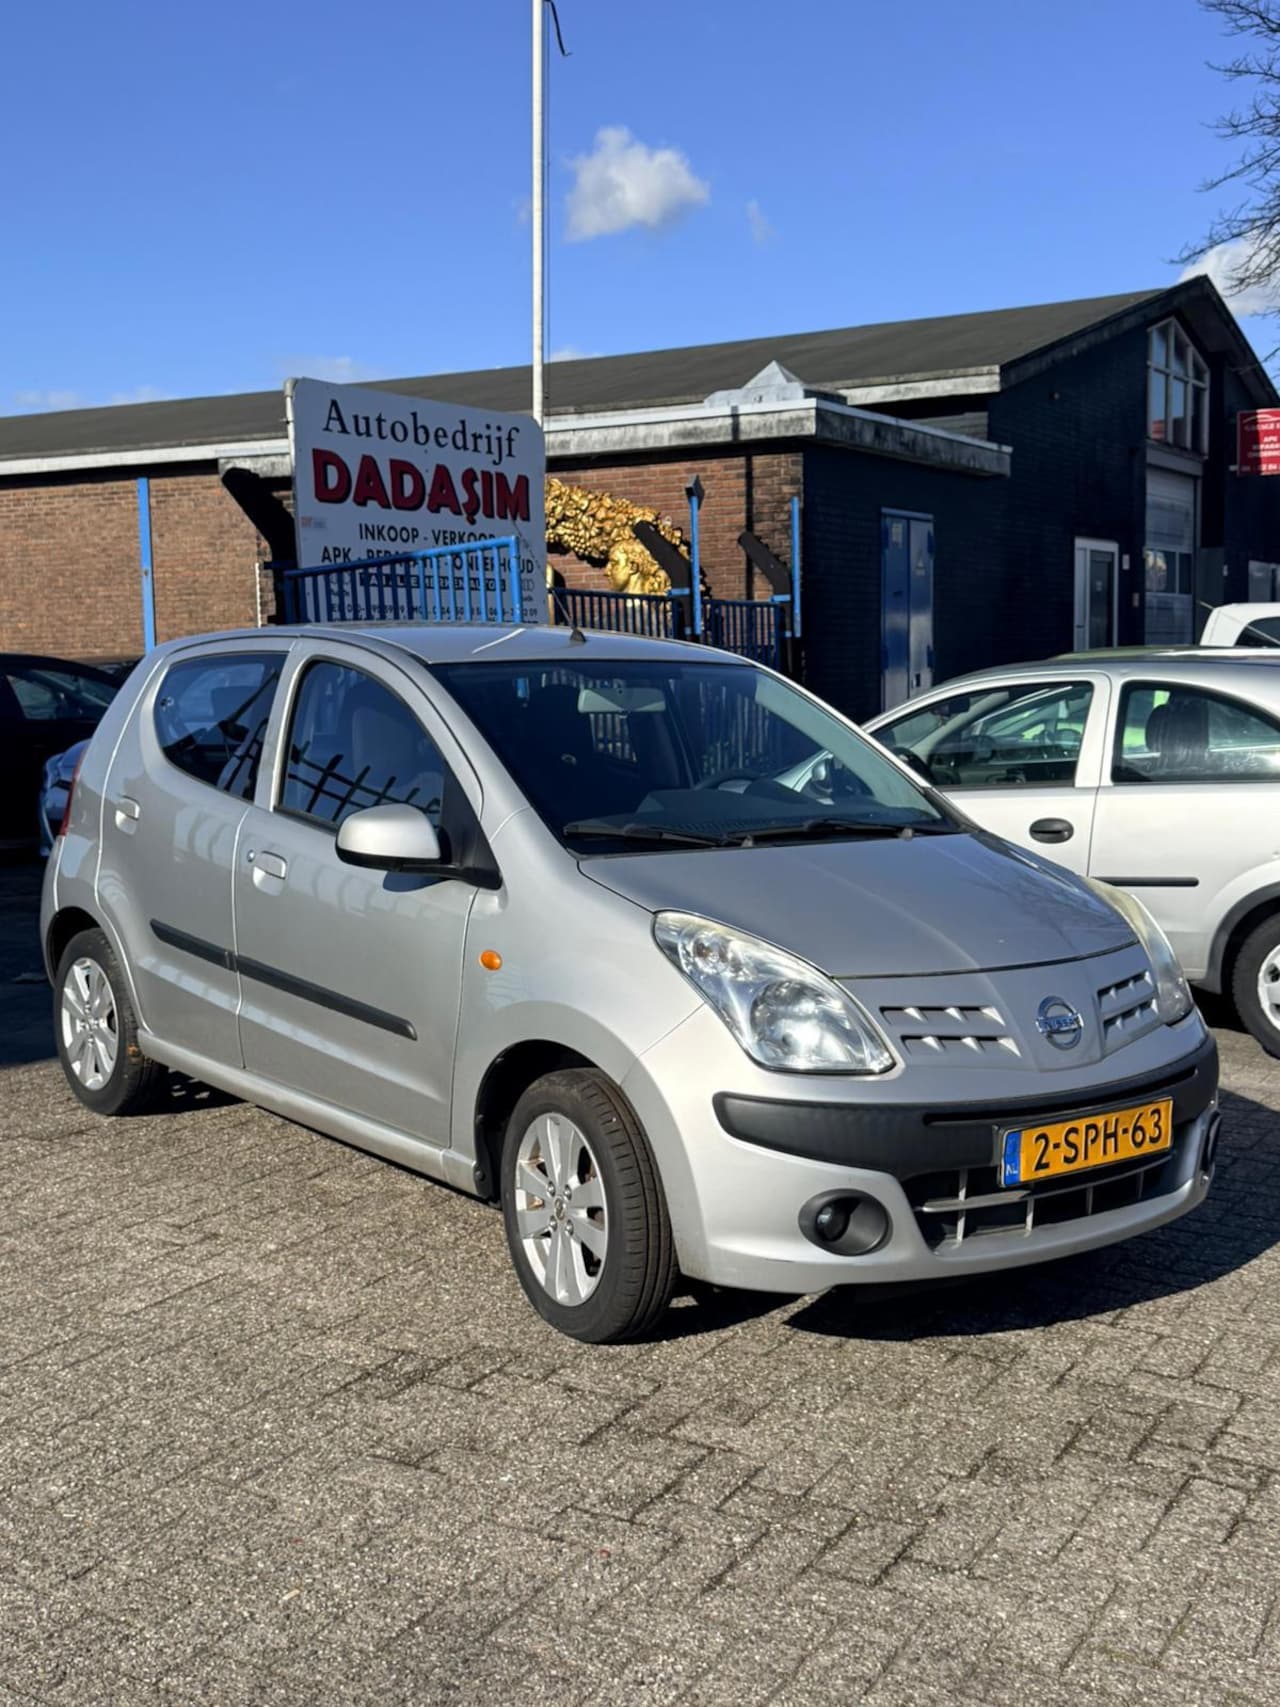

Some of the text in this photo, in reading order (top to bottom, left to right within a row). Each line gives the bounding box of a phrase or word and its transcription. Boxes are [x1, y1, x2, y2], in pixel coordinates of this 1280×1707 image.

[322, 399, 520, 466] Autobedrijf
[312, 448, 530, 526] DADAŞIM
[359, 522, 419, 543] INKOOP
[321, 546, 352, 563] APK
[453, 554, 534, 574] ONEHUD
[1033, 1108, 1162, 1172] 2-SPH-63
[1006, 1165, 1018, 1176] NL
